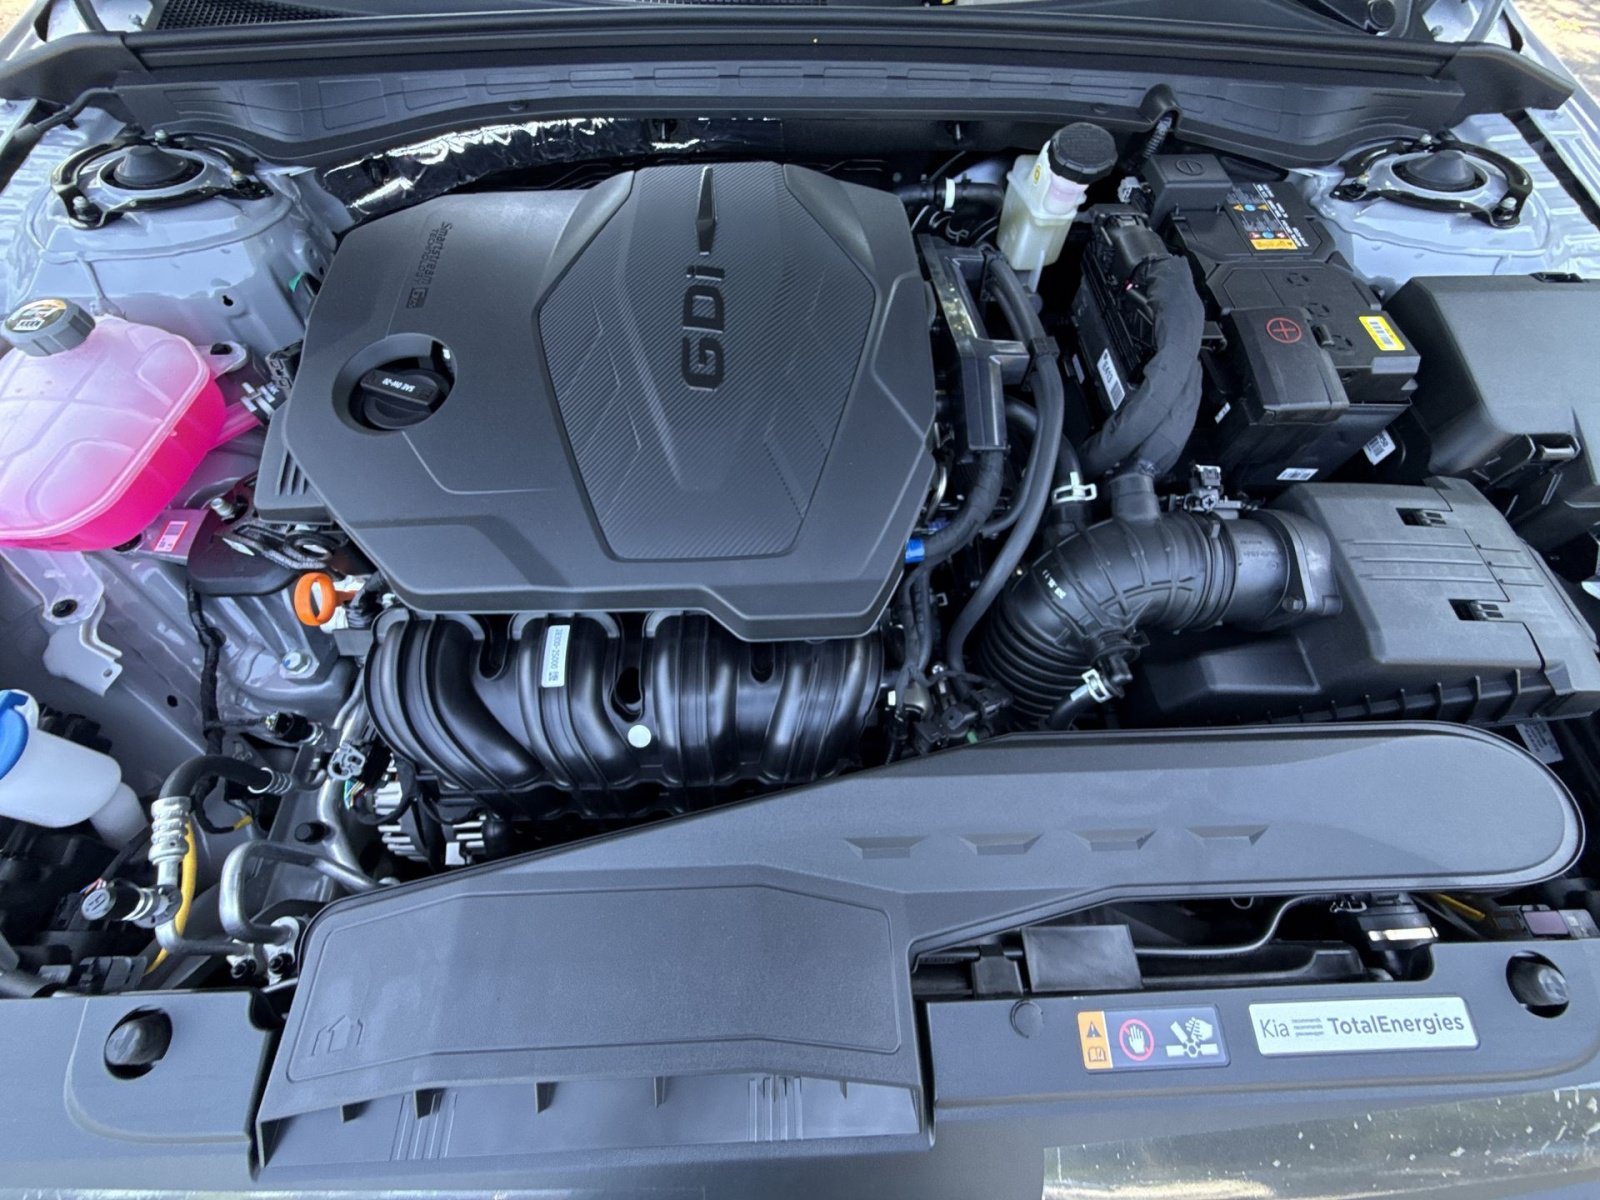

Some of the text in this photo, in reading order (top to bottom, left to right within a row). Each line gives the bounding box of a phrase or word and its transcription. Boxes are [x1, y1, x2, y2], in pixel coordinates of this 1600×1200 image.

[421, 221, 454, 286] Smartstream
[681, 264, 725, 392] GDi
[1260, 1018, 1290, 1039] Kia
[1327, 1012, 1465, 1036] TotalEnergies
